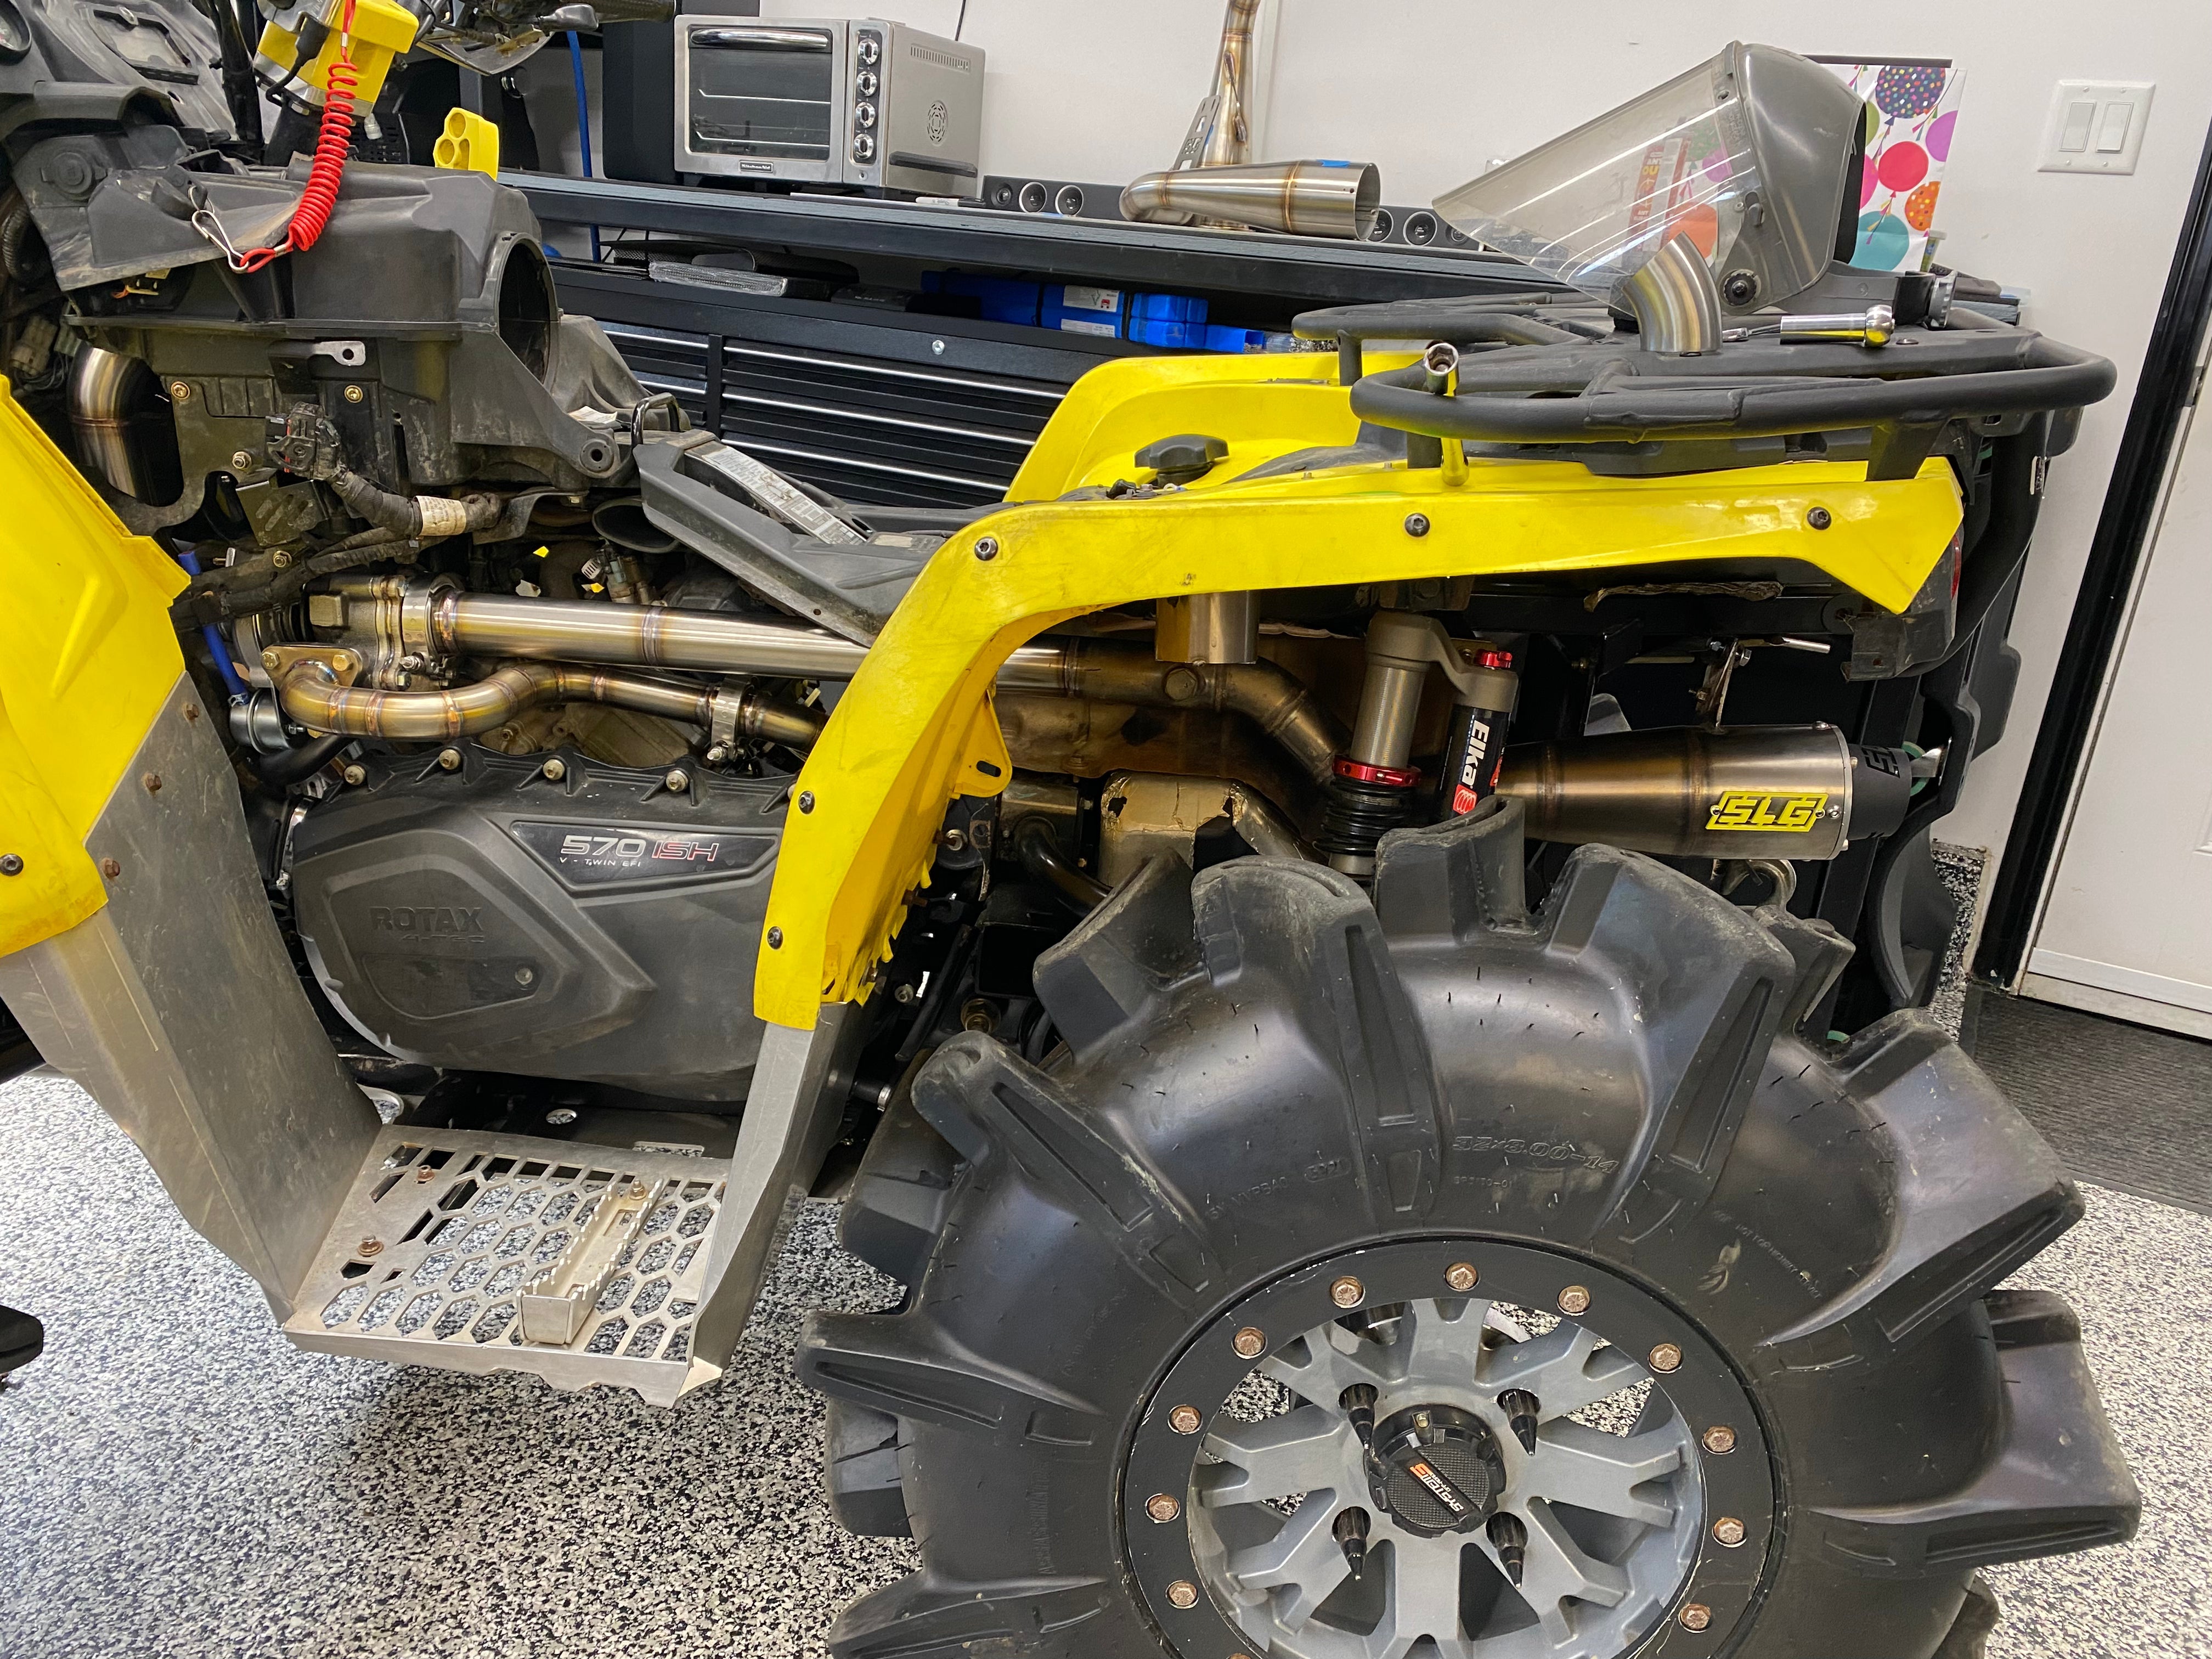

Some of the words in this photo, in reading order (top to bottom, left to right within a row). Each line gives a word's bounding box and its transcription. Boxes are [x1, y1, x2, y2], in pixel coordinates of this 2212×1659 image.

[1462, 720, 1489, 786] Elka
[1718, 799, 1817, 825] SLG
[560, 835, 646, 857] 570
[651, 840, 719, 861] ISH
[369, 906, 484, 932] ROTAX
